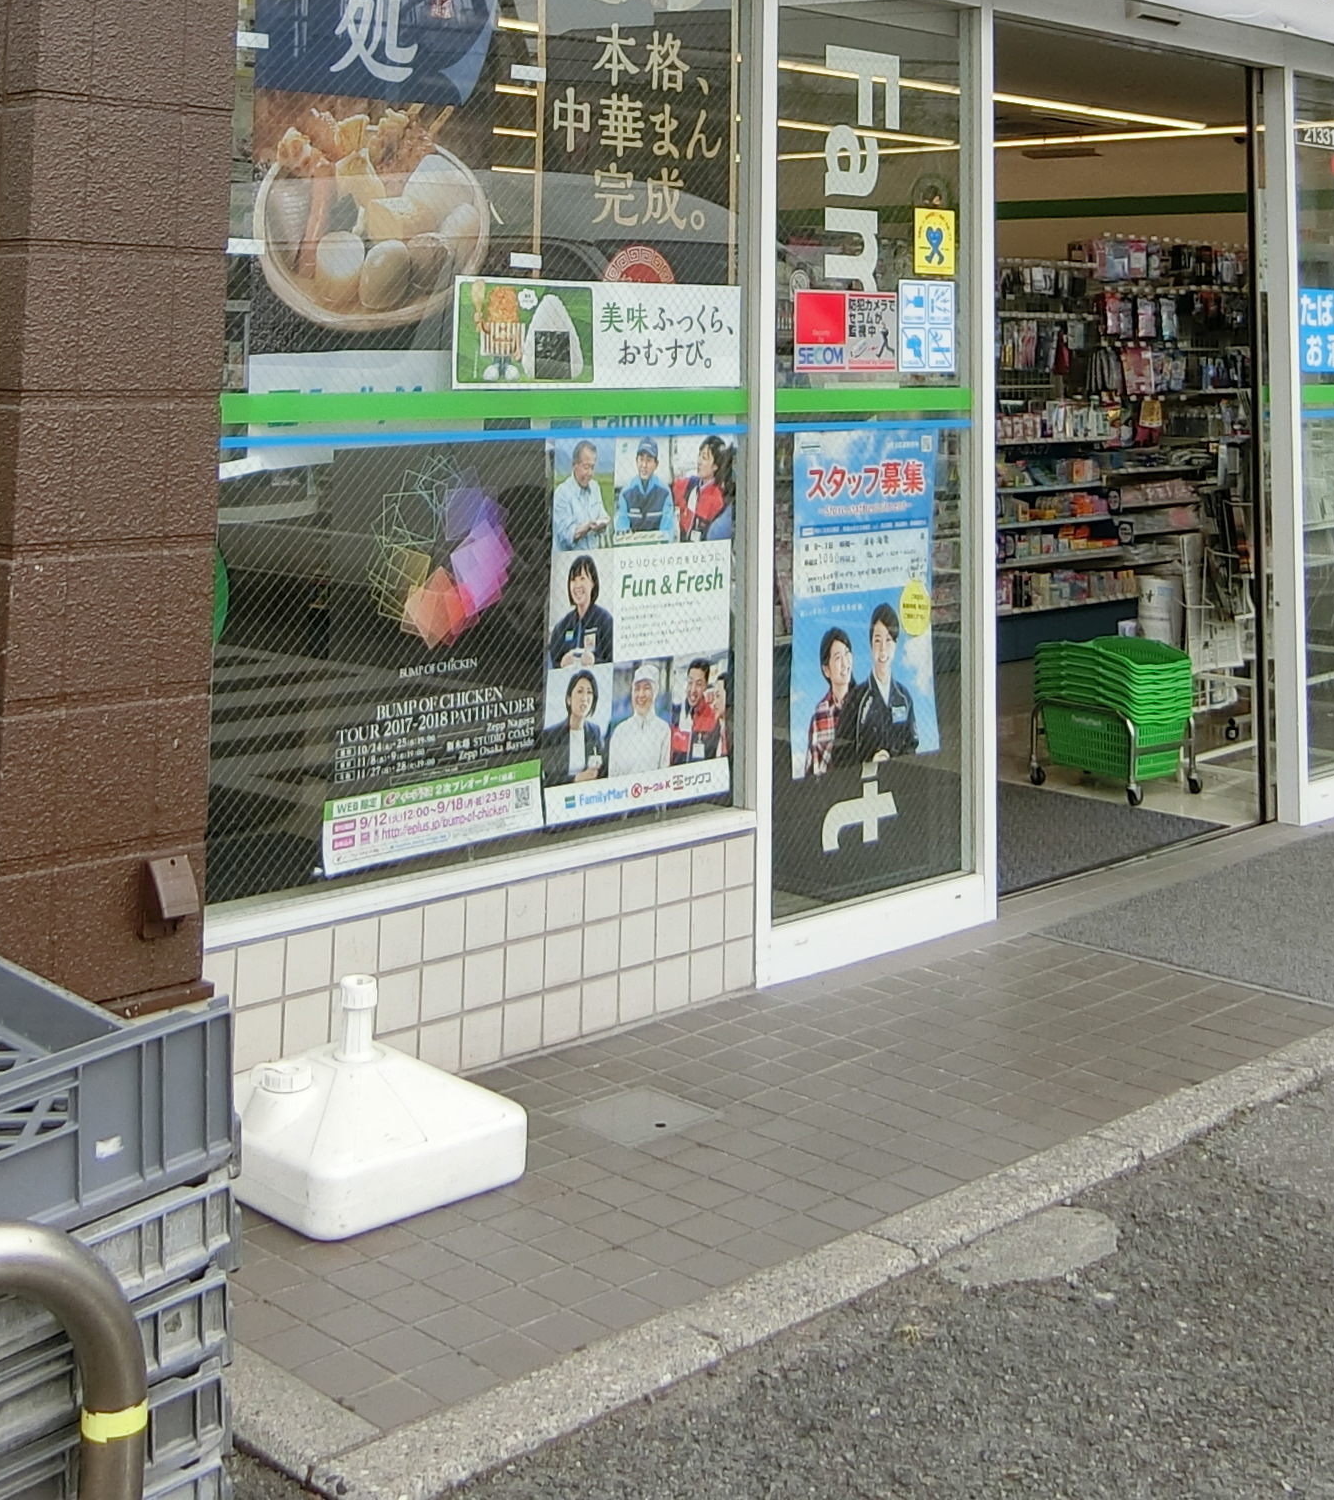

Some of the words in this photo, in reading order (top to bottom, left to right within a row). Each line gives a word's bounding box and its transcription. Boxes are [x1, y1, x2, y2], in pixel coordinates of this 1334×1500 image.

[592, 22, 710, 95] 本格、
[553, 86, 722, 160] 中華まん
[592, 161, 706, 231] 完成。
[600, 301, 734, 335] 美味ふっくら、
[848, 298, 895, 312] 防犯カメラで
[848, 312, 883, 325] セコムが
[618, 338, 712, 369] おむすび。
[798, 347, 843, 364] SECOM
[807, 461, 925, 499] スタッフ募集
[621, 574, 656, 598] Fun
[660, 575, 672, 595] &
[675, 566, 723, 593] Fresh
[376, 700, 417, 722] BUMP
[418, 697, 437, 713] OF
[440, 685, 505, 710] CHICKEN
[336, 723, 380, 746] TOUR
[383, 711, 448, 738] 2017-2018
[450, 697, 536, 725] PATHFINDER
[473, 732, 505, 747] STUDIO
[508, 726, 534, 740] COAST
[580, 788, 628, 806] FamilyMart
